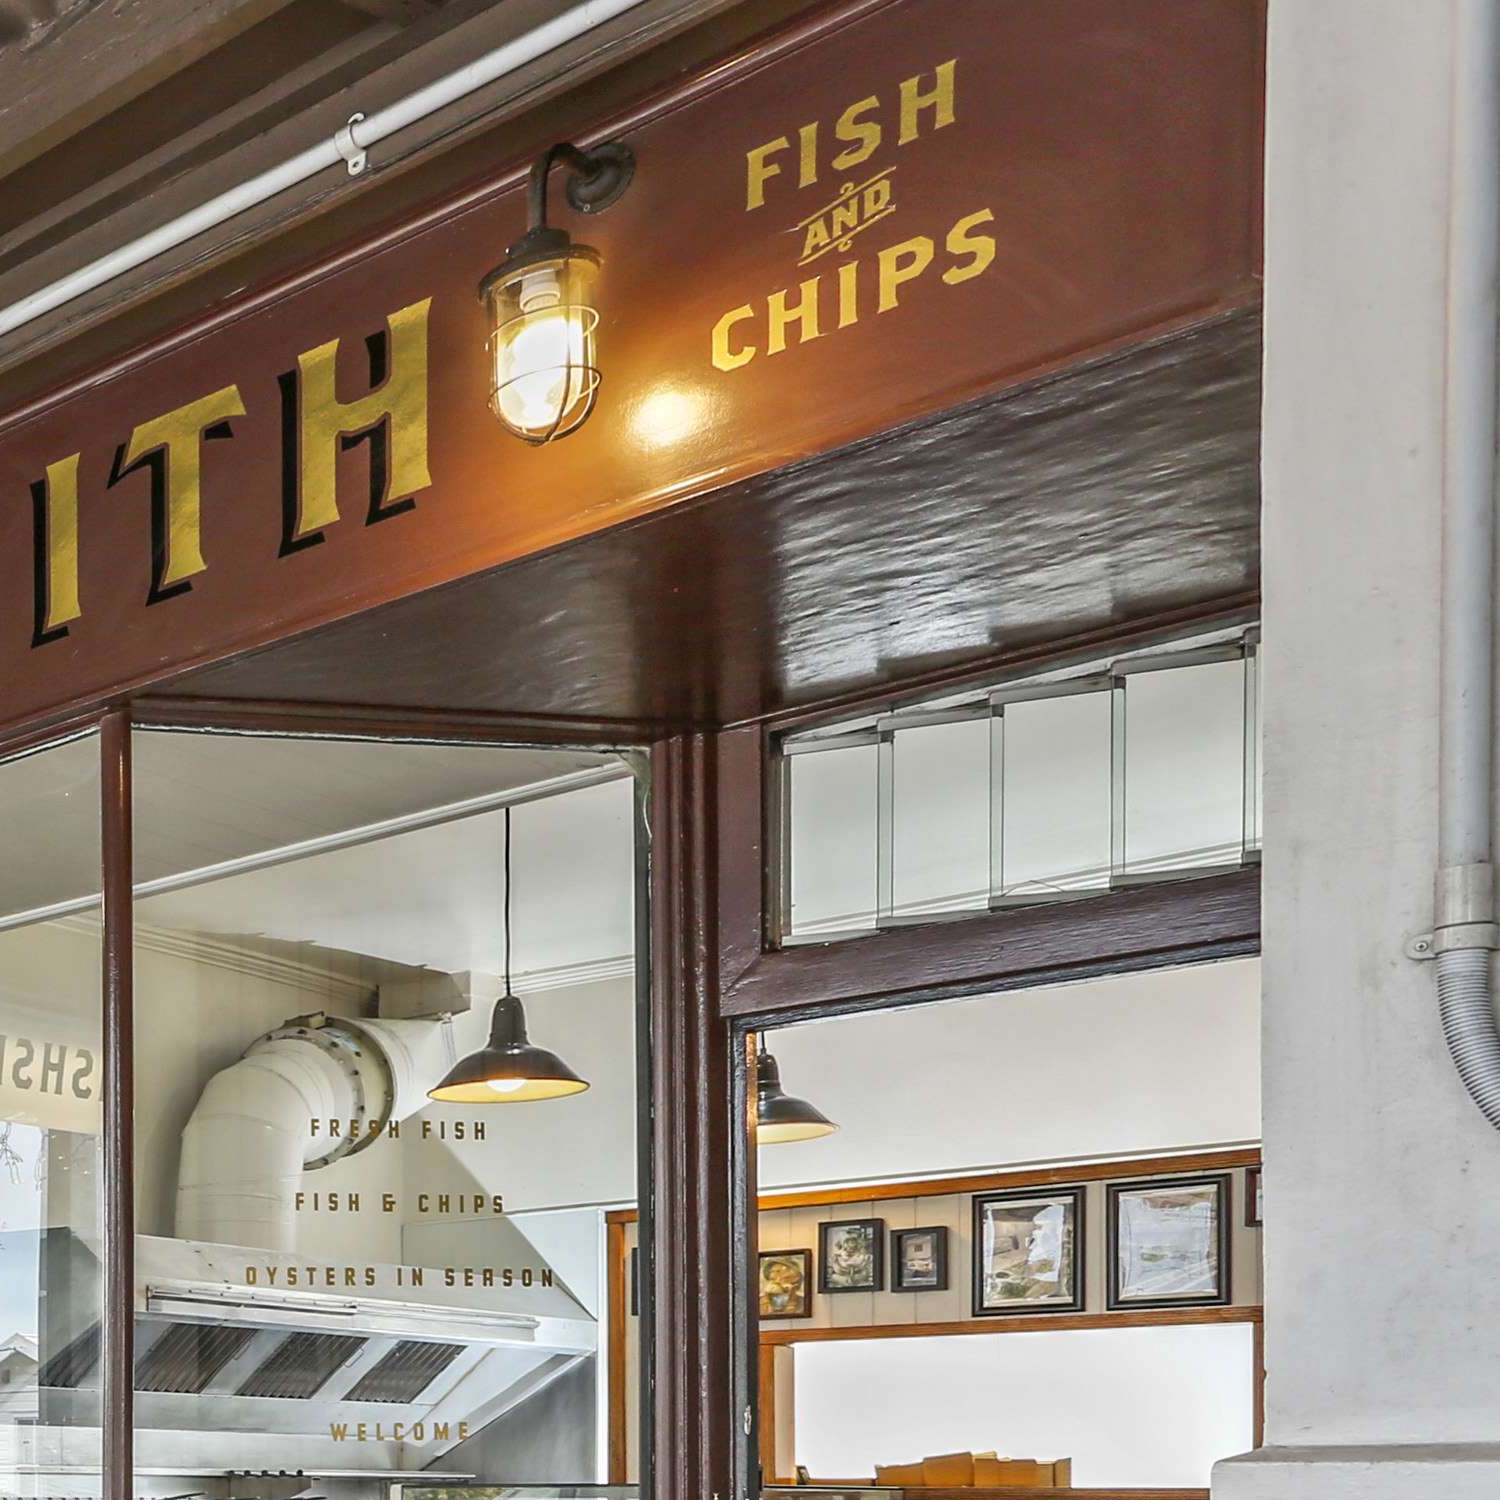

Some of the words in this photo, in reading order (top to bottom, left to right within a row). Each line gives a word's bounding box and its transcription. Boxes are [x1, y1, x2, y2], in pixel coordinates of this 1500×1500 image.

[746, 58, 958, 211] FISH
[802, 179, 892, 257] AND
[711, 208, 996, 372] CHIPS
[310, 1119, 399, 1138] FRESH
[422, 1121, 486, 1140] FISH
[295, 1192, 360, 1211] FISH
[382, 1194, 396, 1212] &
[419, 1194, 503, 1213] CHIPS
[246, 1266, 376, 1286] OYSTERS
[397, 1267, 423, 1286] IN
[444, 1268, 553, 1287] SEASON
[330, 1421, 469, 1441] WELCOME
